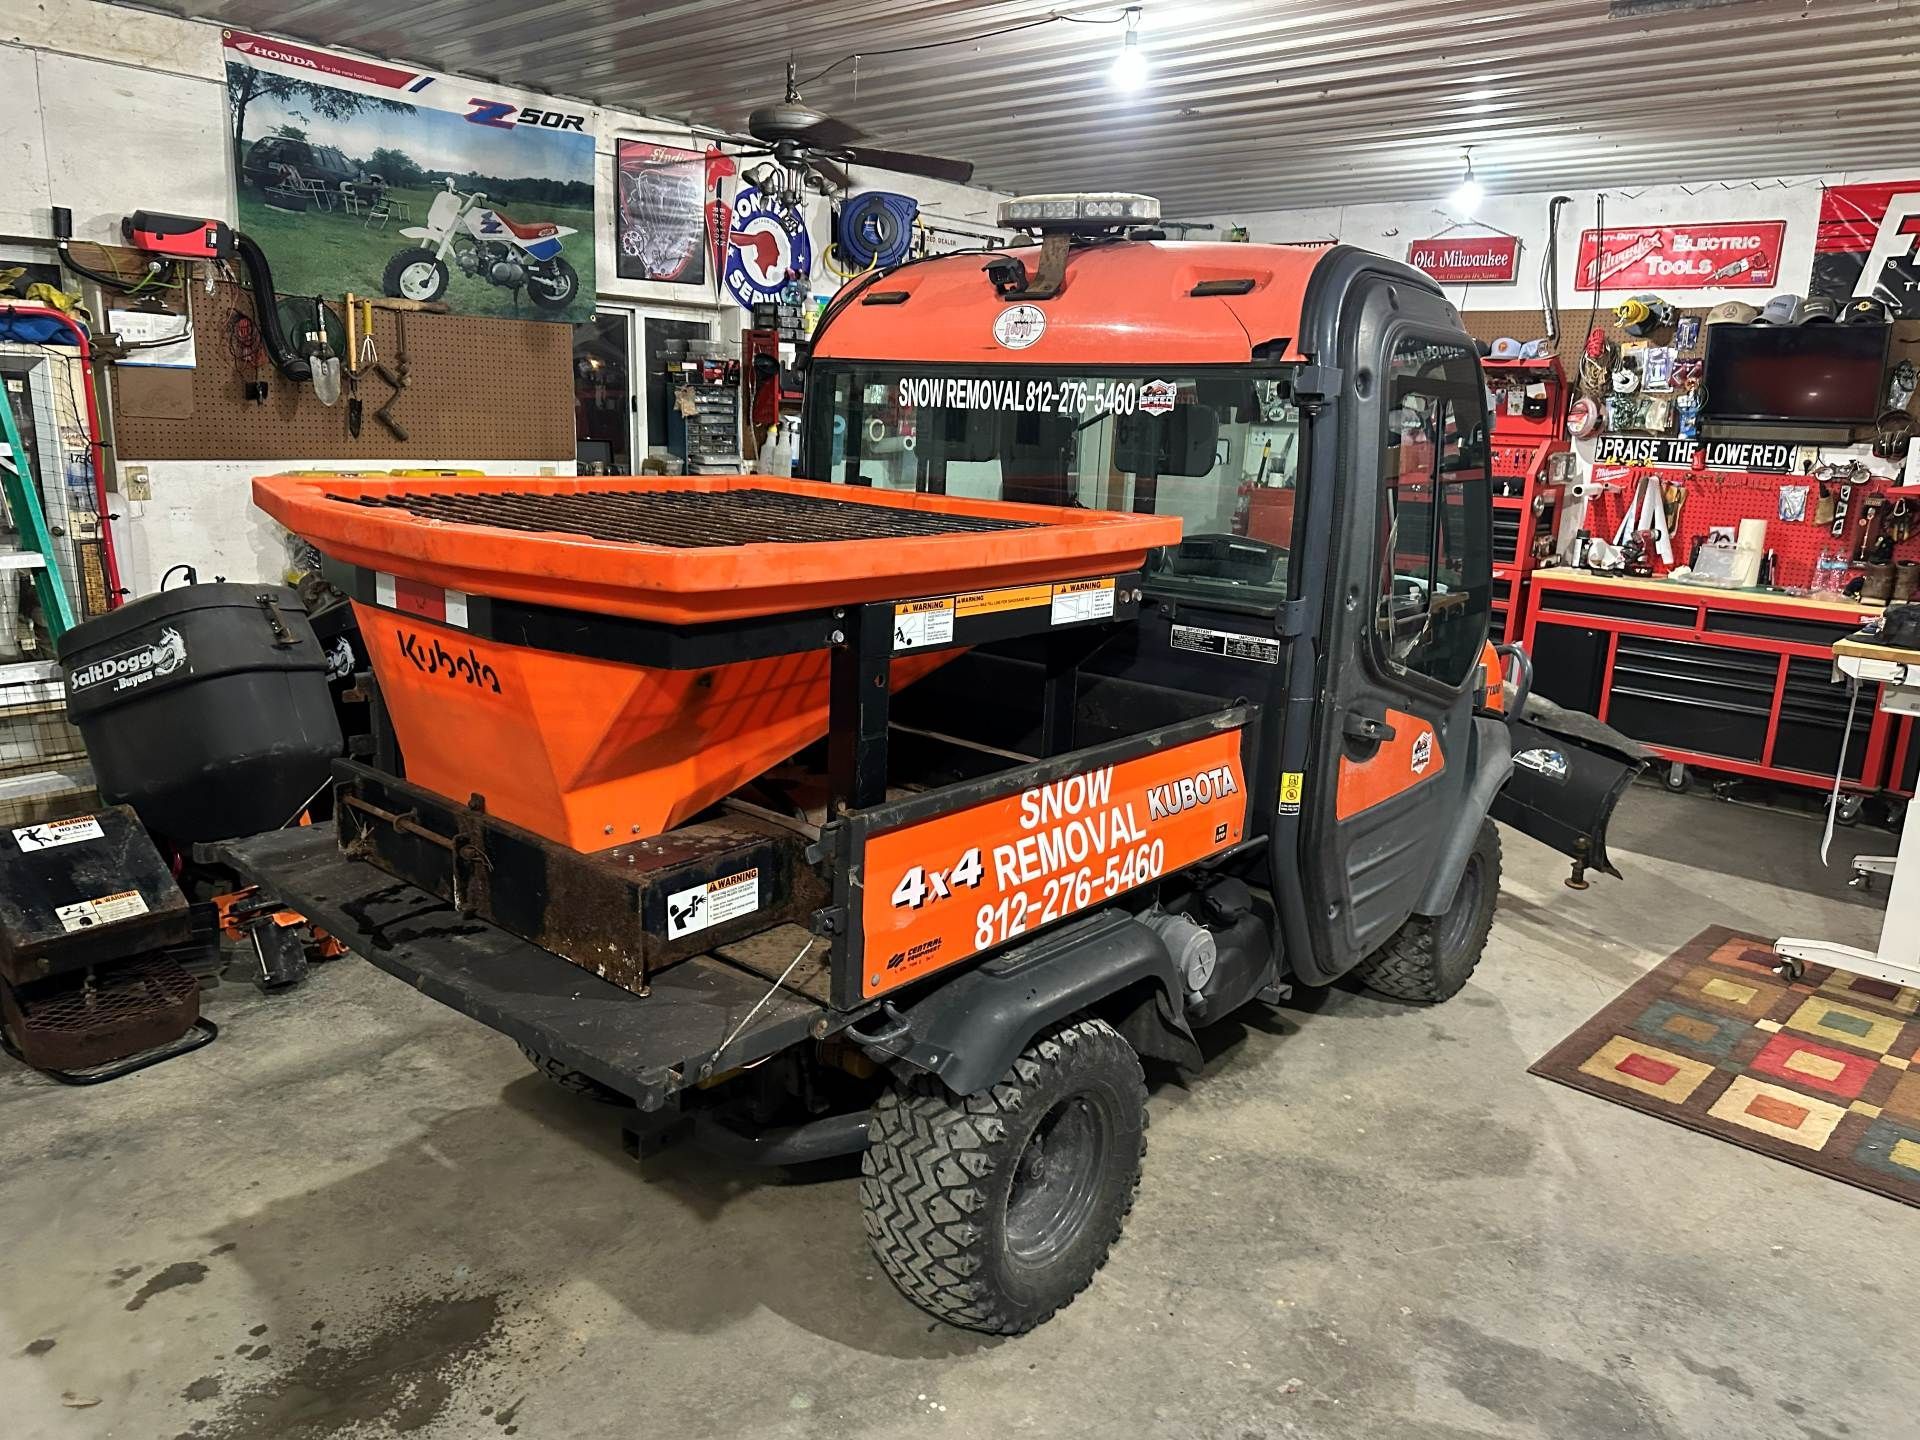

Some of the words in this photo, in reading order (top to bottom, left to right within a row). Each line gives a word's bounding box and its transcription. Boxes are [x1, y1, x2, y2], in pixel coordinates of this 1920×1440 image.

[254, 46, 318, 69] HONDA
[1673, 233, 1761, 252] ELECTRIC
[1414, 250, 1437, 269] Old
[1440, 249, 1509, 267] Milwaukee
[1644, 254, 1713, 276] TOOLS
[899, 378, 945, 408] SNOW
[946, 379, 1026, 412] REMOVAL
[1026, 381, 1135, 416] 812-276-5460
[1604, 440, 1659, 462] PRAISE
[1667, 441, 1699, 463] THE
[1705, 444, 1788, 467] LOWERED
[1069, 581, 1101, 592] WARNING
[912, 601, 944, 612] WARNING
[70, 651, 154, 690] SaltDogg
[397, 630, 502, 694] Kubota
[119, 670, 154, 690] Buyers
[1018, 763, 1115, 830] SNOW
[1146, 765, 1239, 822] KUBOTA
[57, 816, 94, 828] WARNING
[72, 822, 94, 831] STEP
[992, 803, 1147, 892] REMOVAL
[718, 869, 757, 889] WARNING
[891, 847, 985, 911] 4x4
[974, 838, 1165, 950] 812-276-5460
[907, 936, 943, 956] CENTRAL
